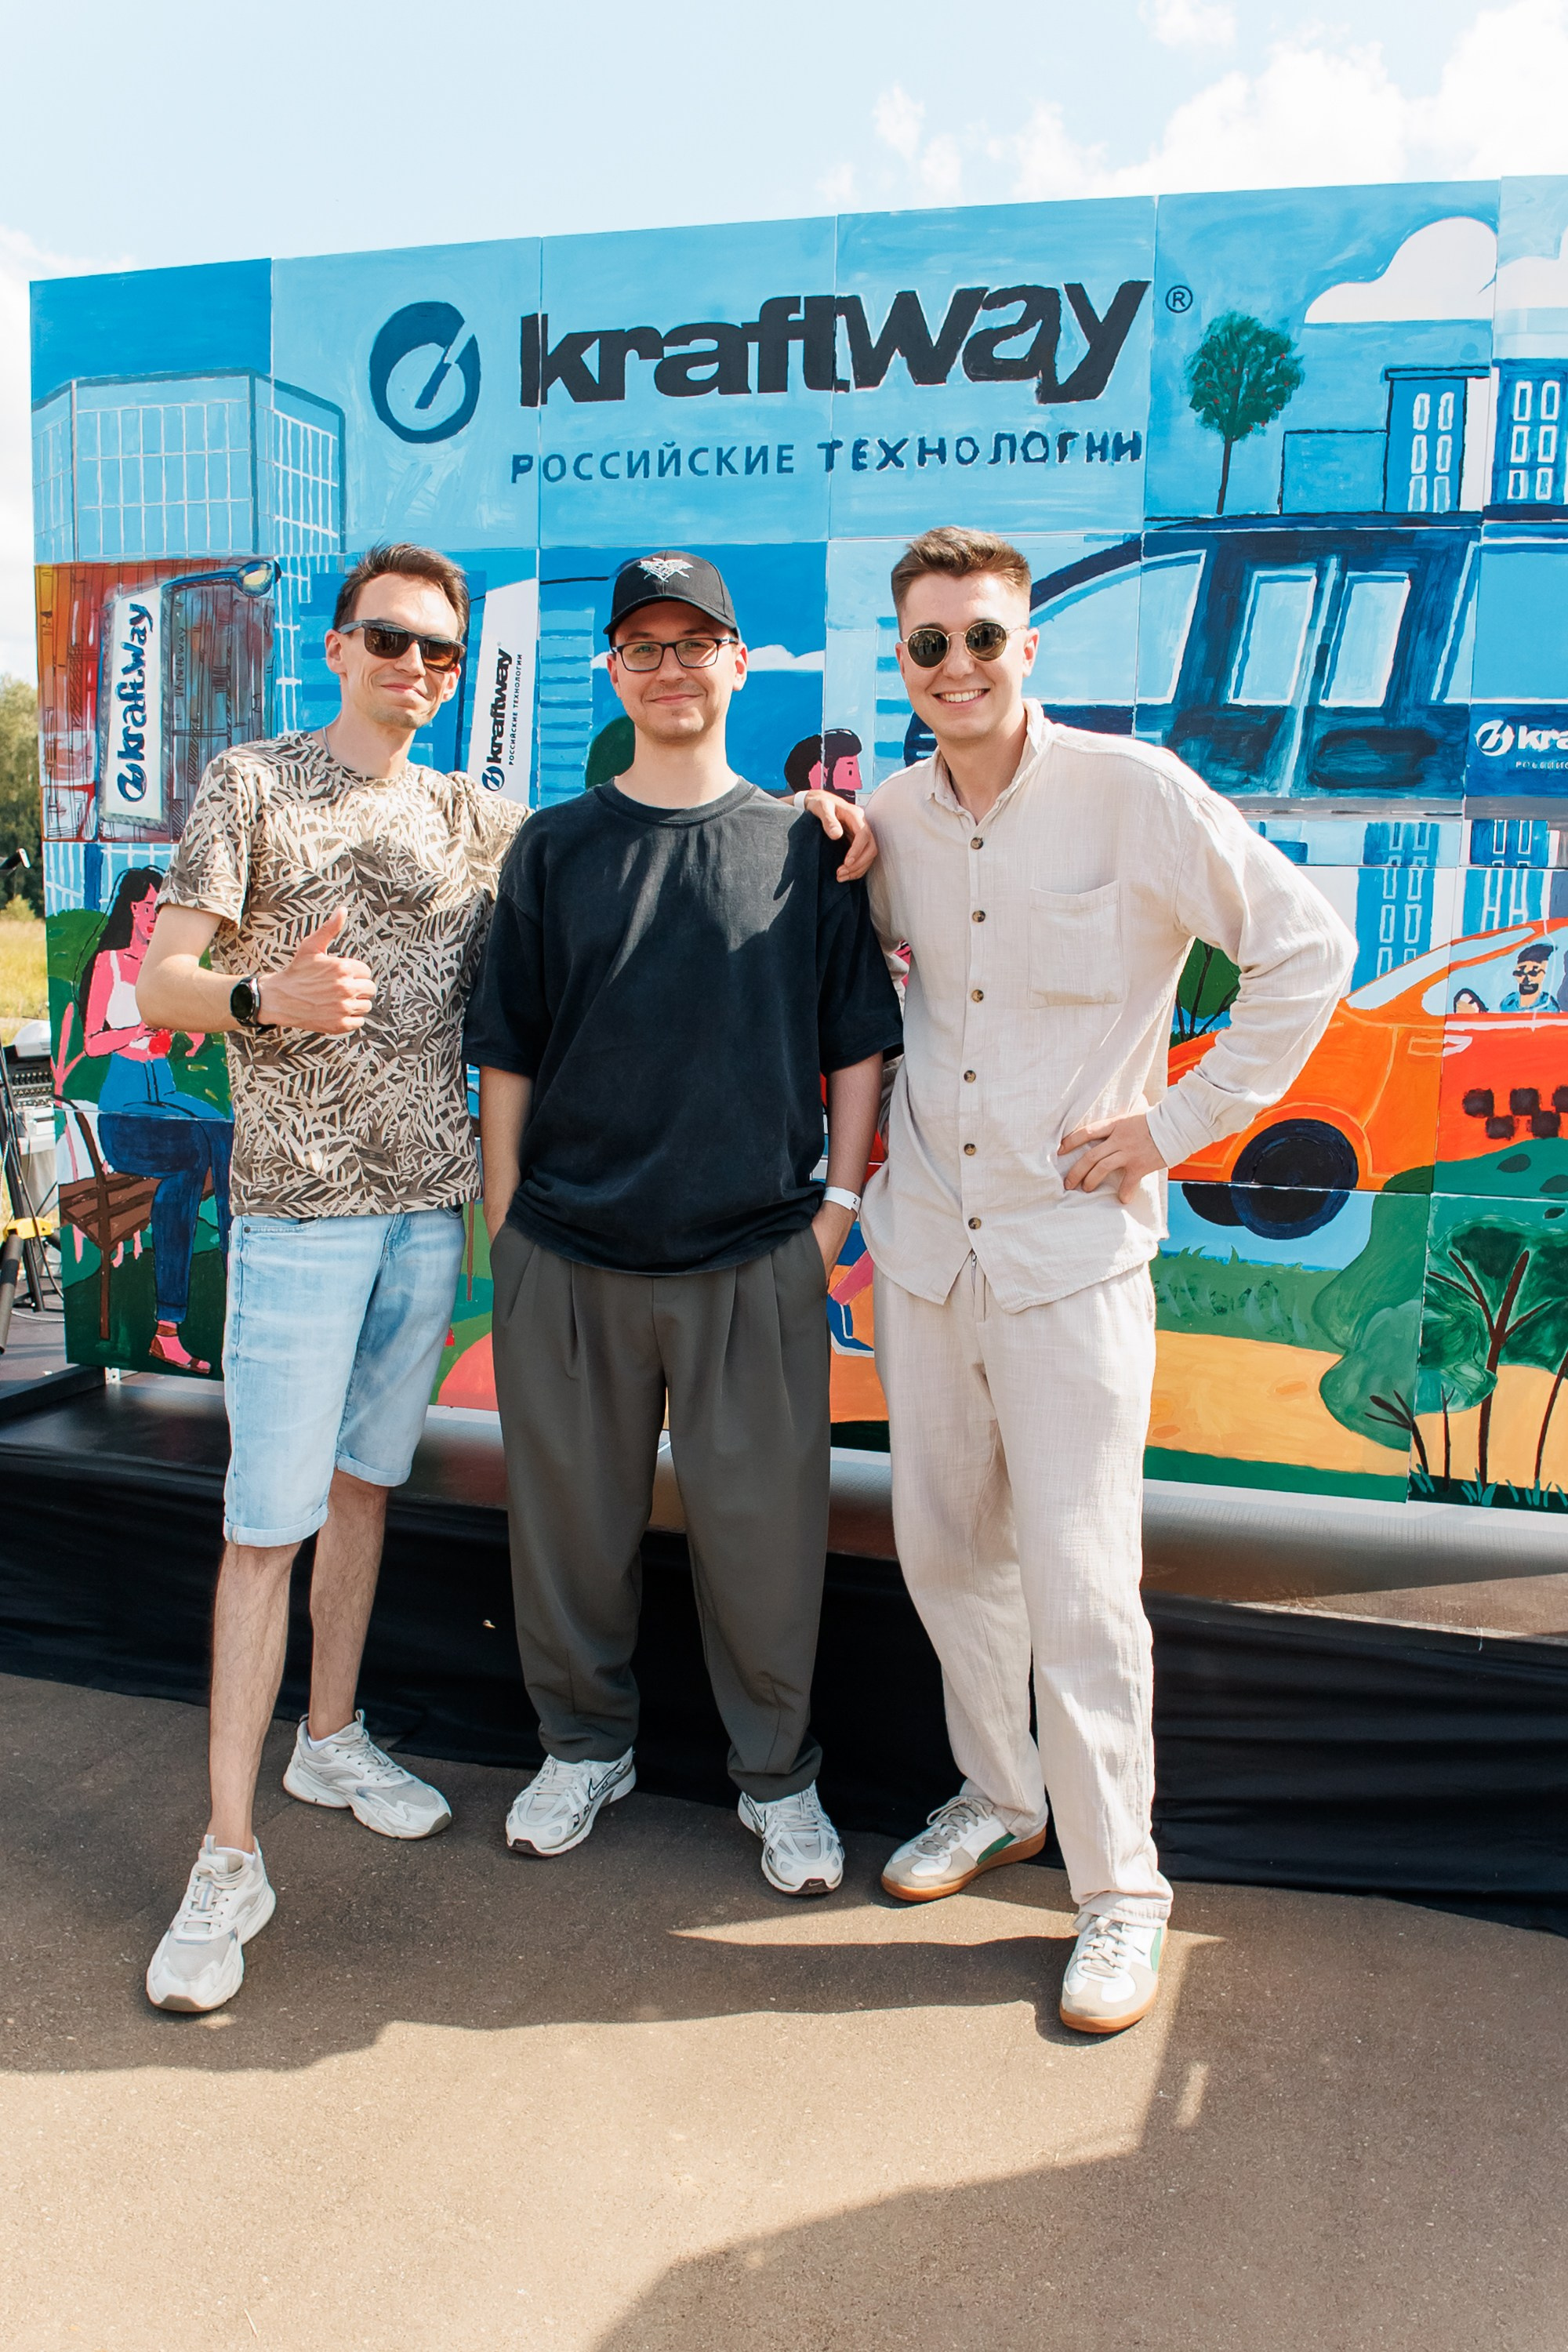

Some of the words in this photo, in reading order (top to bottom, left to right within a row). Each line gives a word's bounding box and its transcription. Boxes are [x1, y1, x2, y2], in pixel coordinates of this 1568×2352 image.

[521, 280, 1152, 408] kraftway
[511, 440, 794, 484] РОССИЙСКИЕ
[486, 648, 513, 764] kraftway
[513, 654, 522, 709] ТЕХНОЛОГИИ
[509, 712, 518, 766] РОССИЙСКИЕ
